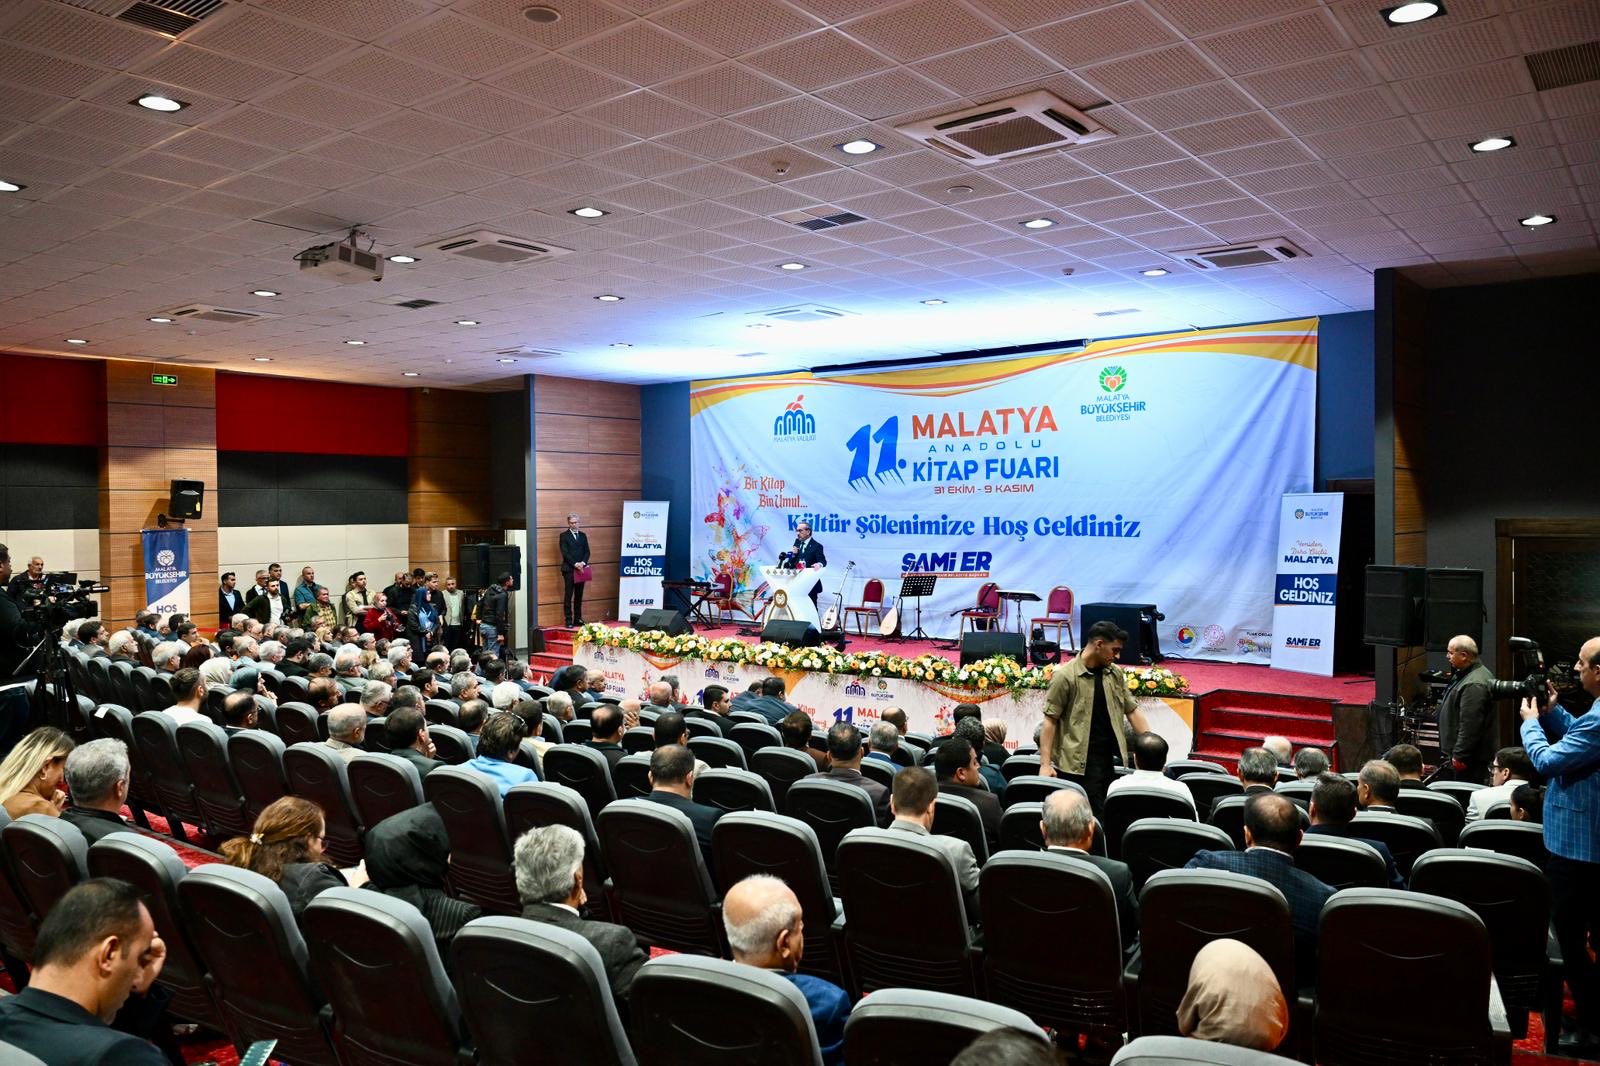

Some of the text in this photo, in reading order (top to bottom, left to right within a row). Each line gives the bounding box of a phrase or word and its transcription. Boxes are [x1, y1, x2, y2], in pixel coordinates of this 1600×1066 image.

[1096, 394, 1130, 402] MALATYA
[912, 405, 1058, 440] MALATYA
[928, 439, 1041, 453] ANADOLU
[912, 455, 1059, 482] KİTAP FUARI
[934, 486, 945, 494] 31
[948, 484, 975, 494] EKİM
[984, 485, 992, 494] 9
[995, 484, 1034, 493] KASIM
[856, 514, 975, 540] Şölenimize
[983, 516, 1028, 542] Hoş
[1034, 514, 1141, 538] Geldiniz
[960, 551, 992, 571] ER
[1284, 555, 1334, 565] MALATYA
[1294, 577, 1319, 590] HOŞ
[1309, 639, 1321, 647] ER
[602, 670, 625, 681] ALATYA
